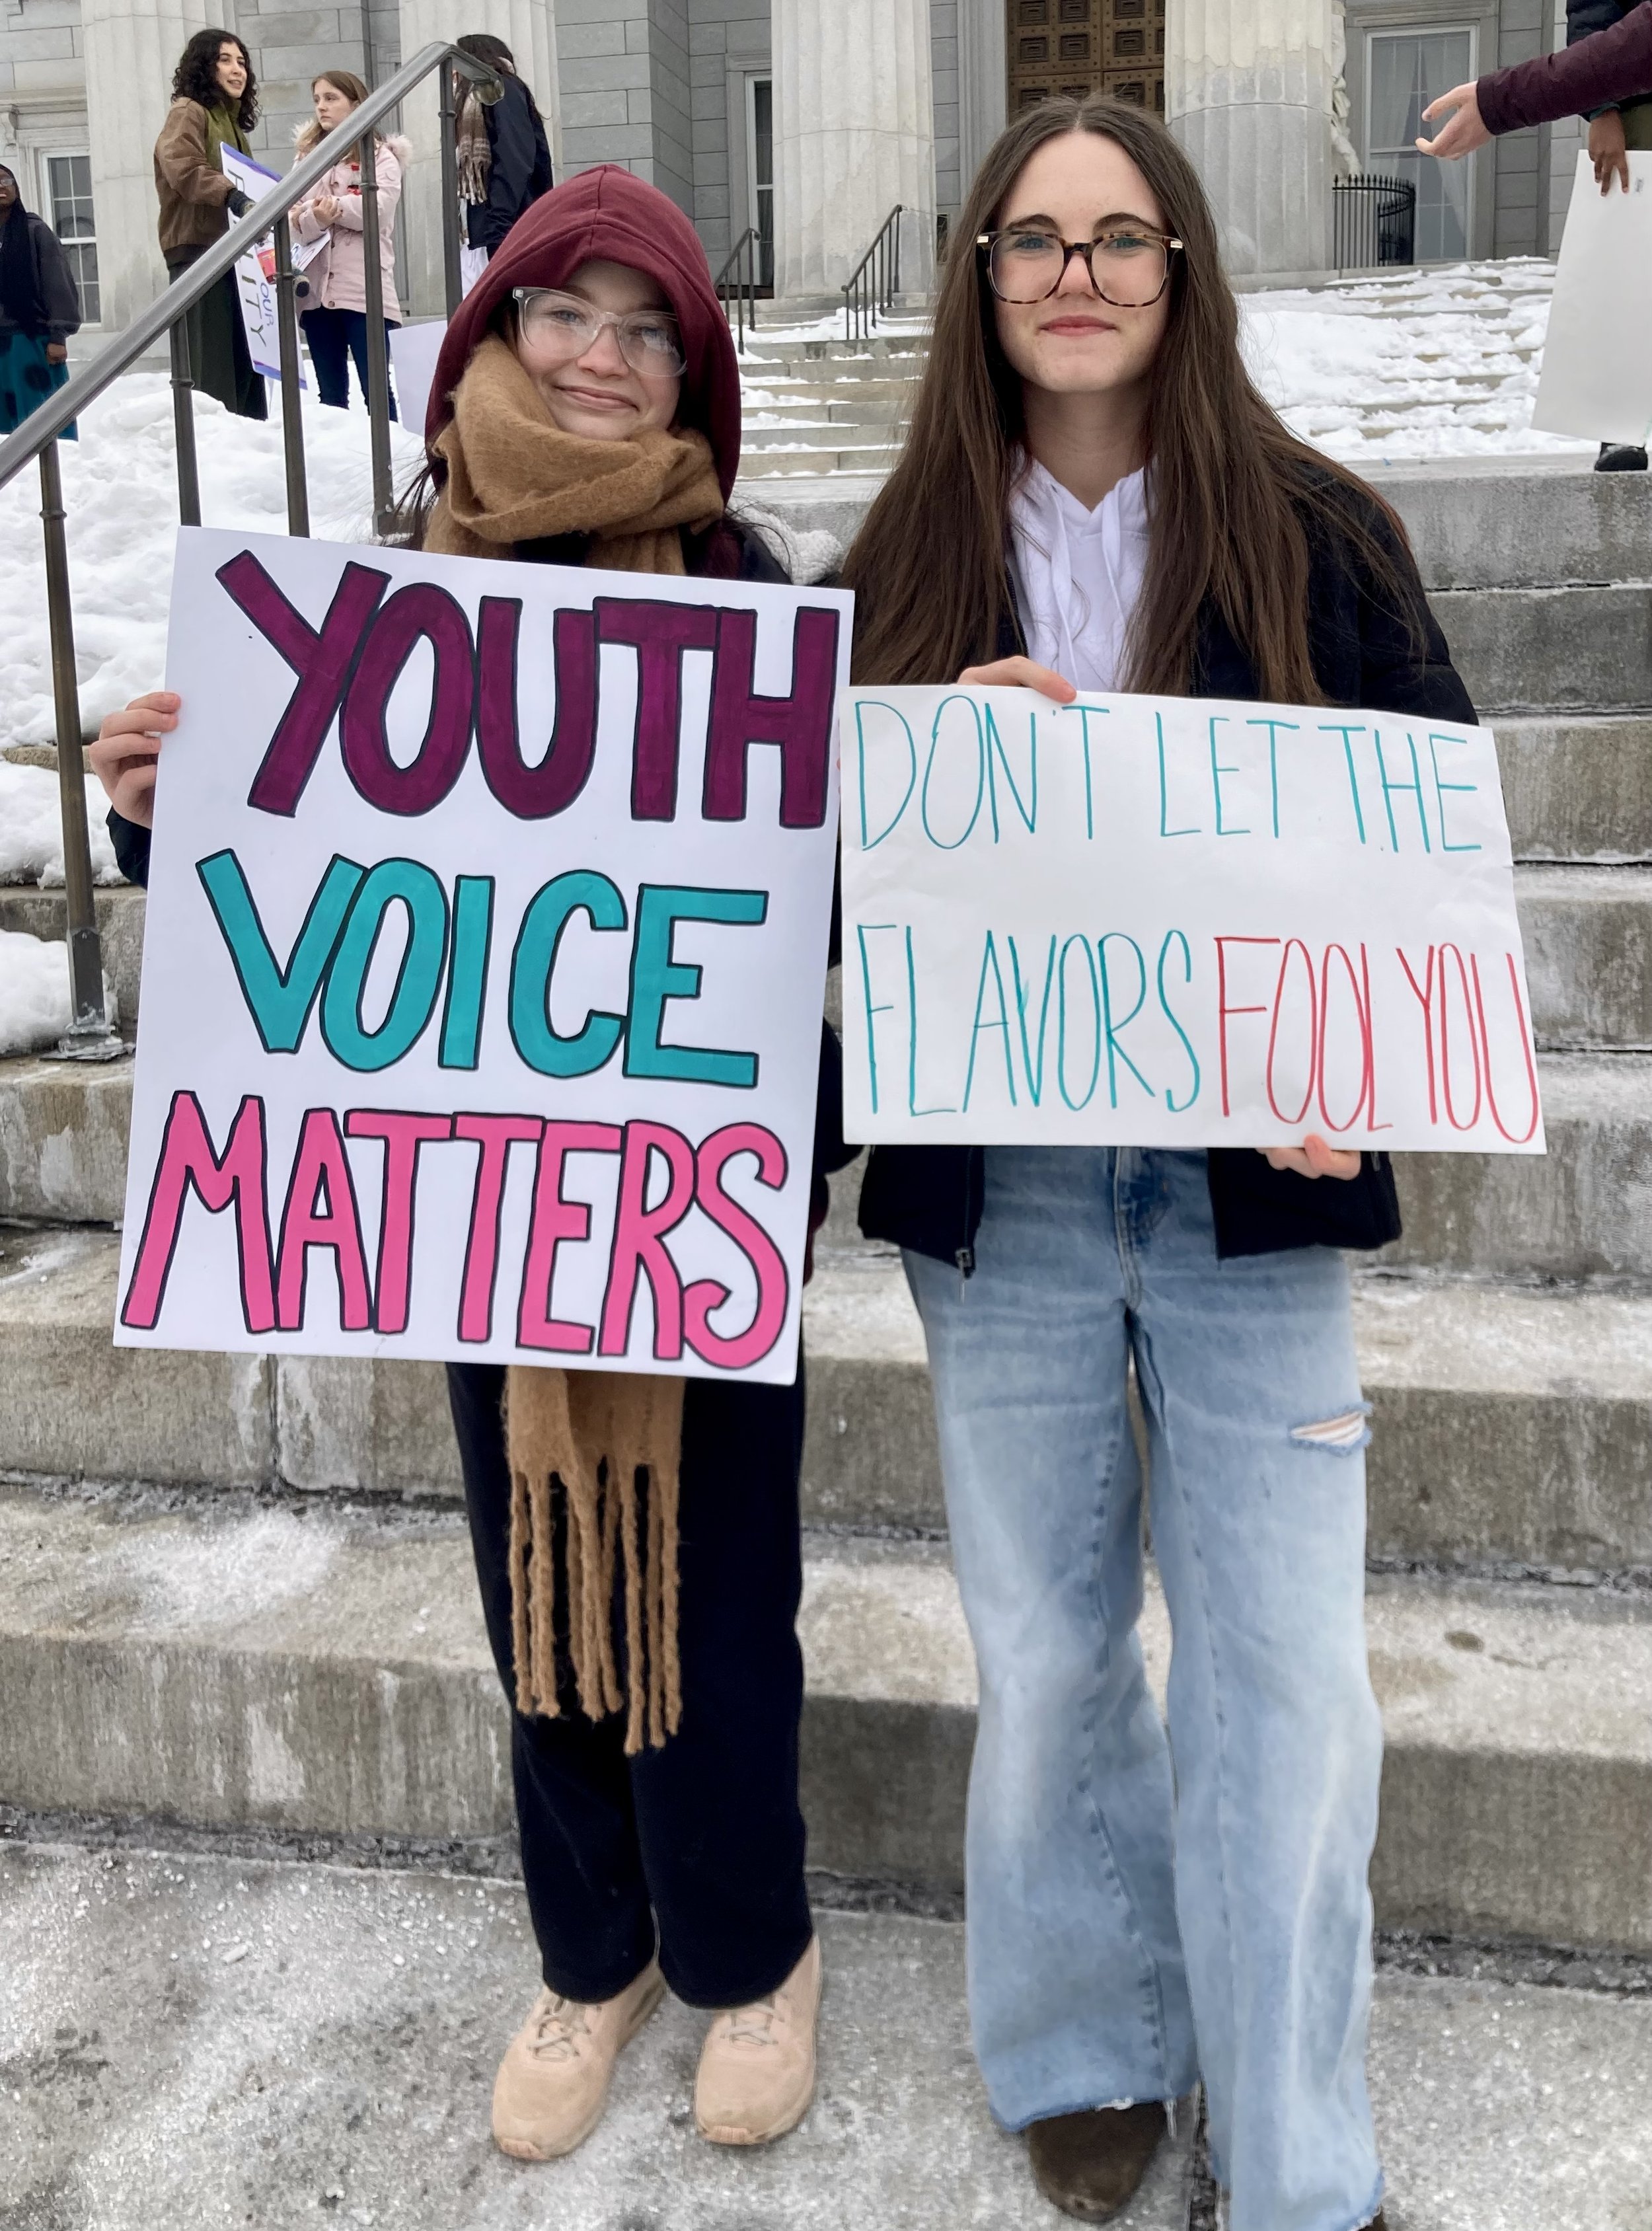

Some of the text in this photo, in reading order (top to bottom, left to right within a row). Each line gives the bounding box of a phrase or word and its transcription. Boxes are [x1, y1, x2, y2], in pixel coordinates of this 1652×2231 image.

[215, 549, 840, 829] YOUTH
[856, 695, 1482, 853] DON'T LET THE
[196, 849, 769, 1088] VOICE
[858, 925, 1538, 1143] FLAVORS FOOL YOU
[121, 1090, 789, 1369] MATTERS
